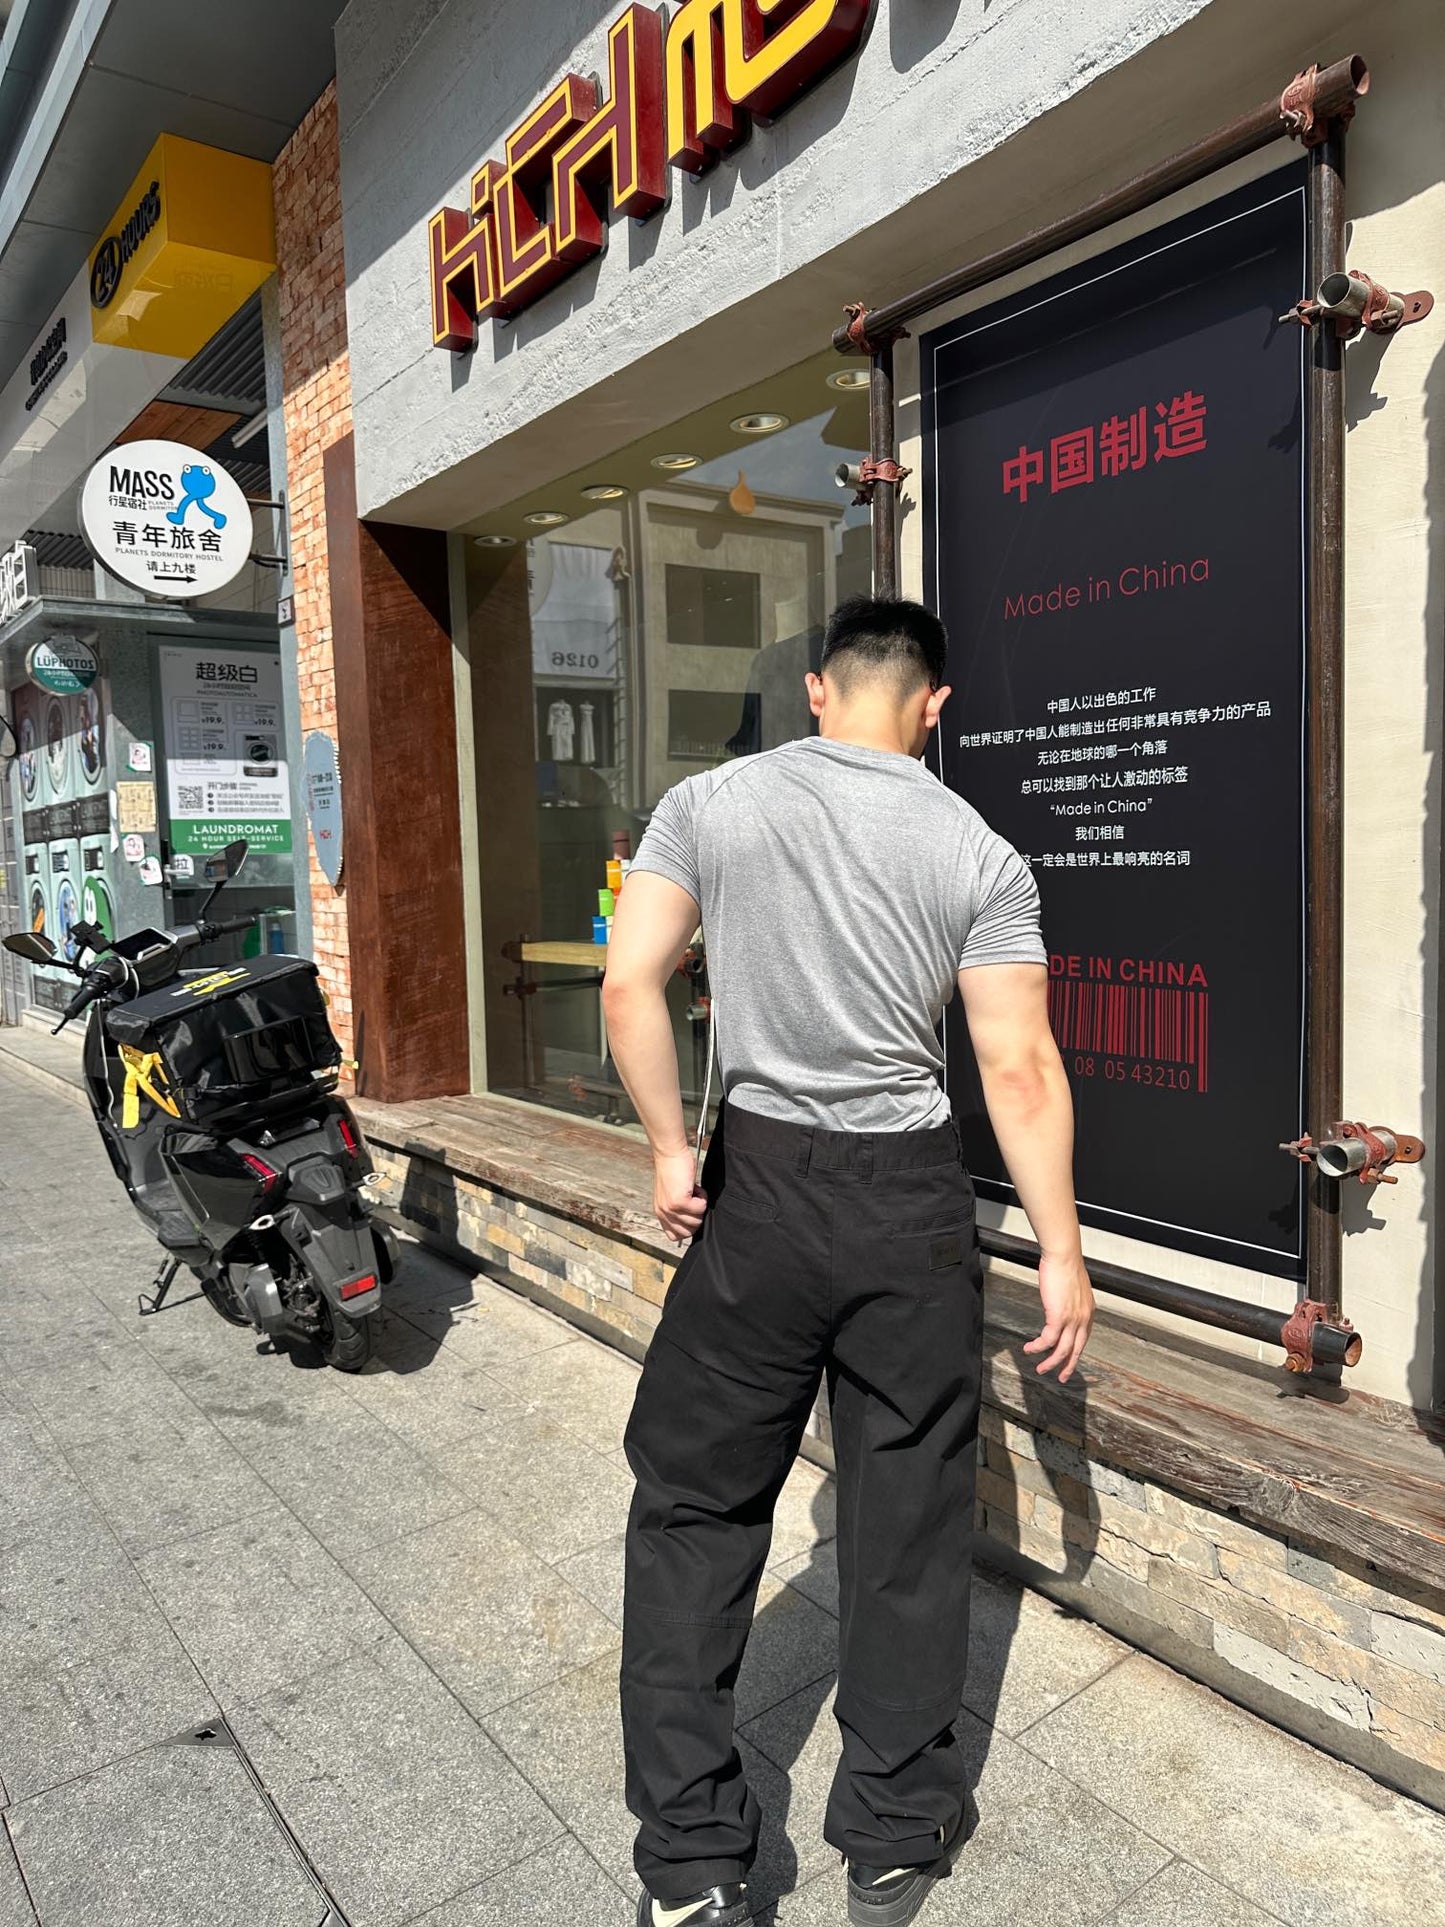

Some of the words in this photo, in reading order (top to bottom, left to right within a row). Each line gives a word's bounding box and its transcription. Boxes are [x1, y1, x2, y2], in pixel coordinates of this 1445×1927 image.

[1002, 390, 1208, 504] 中国制造
[109, 465, 175, 500] MASS
[112, 521, 222, 552] 青年旅舍
[115, 547, 149, 557] PLANETS
[150, 551, 194, 560] DORMITORY
[146, 560, 197, 574] 请上九楼
[1003, 582, 1081, 621] Made
[1088, 576, 1111, 603] in
[1118, 558, 1210, 596] China
[195, 662, 258, 683] 超级白
[1047, 686, 1157, 714] 中国人以出色的工作
[959, 700, 1272, 748] 向世界证明了中国人能制造出任何非常具有竞争力的产品
[1037, 739, 1168, 766] 无论在地球的哪一个角落
[1021, 765, 1189, 795] 总可以找到那个让人激动的标签
[1050, 802, 1092, 816] “Made
[1094, 801, 1105, 814] in
[1107, 797, 1153, 814] China”
[193, 824, 279, 835] LAUNDROMAT
[1075, 824, 1125, 841] 我们相信
[1049, 954, 1082, 977] DE
[1088, 956, 1112, 980] IN
[1119, 957, 1209, 988] CHINA
[1074, 1055, 1095, 1077] 08
[1130, 1062, 1191, 1091] 43210
